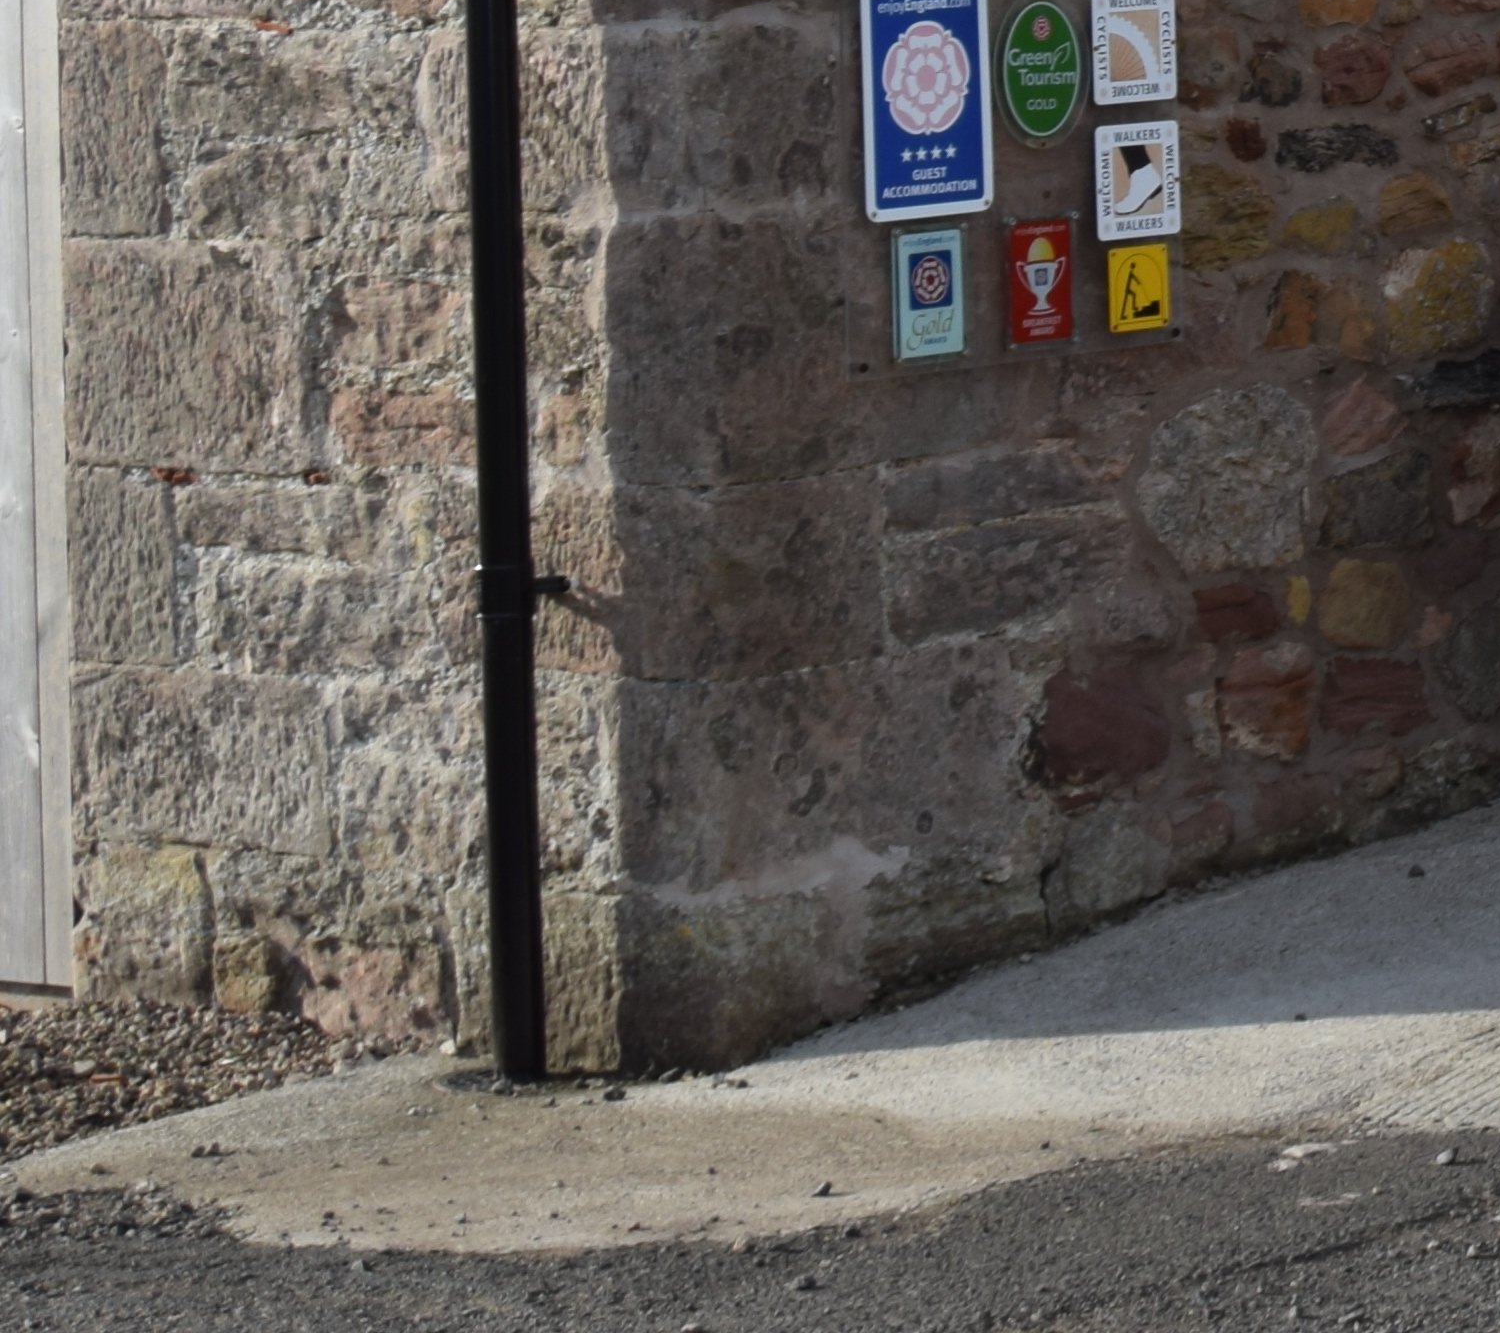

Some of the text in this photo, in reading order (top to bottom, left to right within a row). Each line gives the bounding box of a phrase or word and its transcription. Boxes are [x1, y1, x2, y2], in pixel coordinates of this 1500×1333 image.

[1097, 15, 1107, 81] CYCLISTS
[1161, 10, 1171, 76] CYCLISTS
[1008, 48, 1055, 68] Green
[1018, 69, 1077, 86] Tourism
[1112, 83, 1161, 98] WELCOME
[1026, 98, 1058, 112] GOLD
[1114, 128, 1162, 143] WALKERS
[912, 167, 948, 181] GUEST
[1097, 150, 1112, 217] WELCOME
[1165, 144, 1177, 211] WELCOME
[882, 179, 978, 200] ACCOMMODATION
[1116, 217, 1165, 233] WALKERS
[906, 309, 955, 351] Gold
